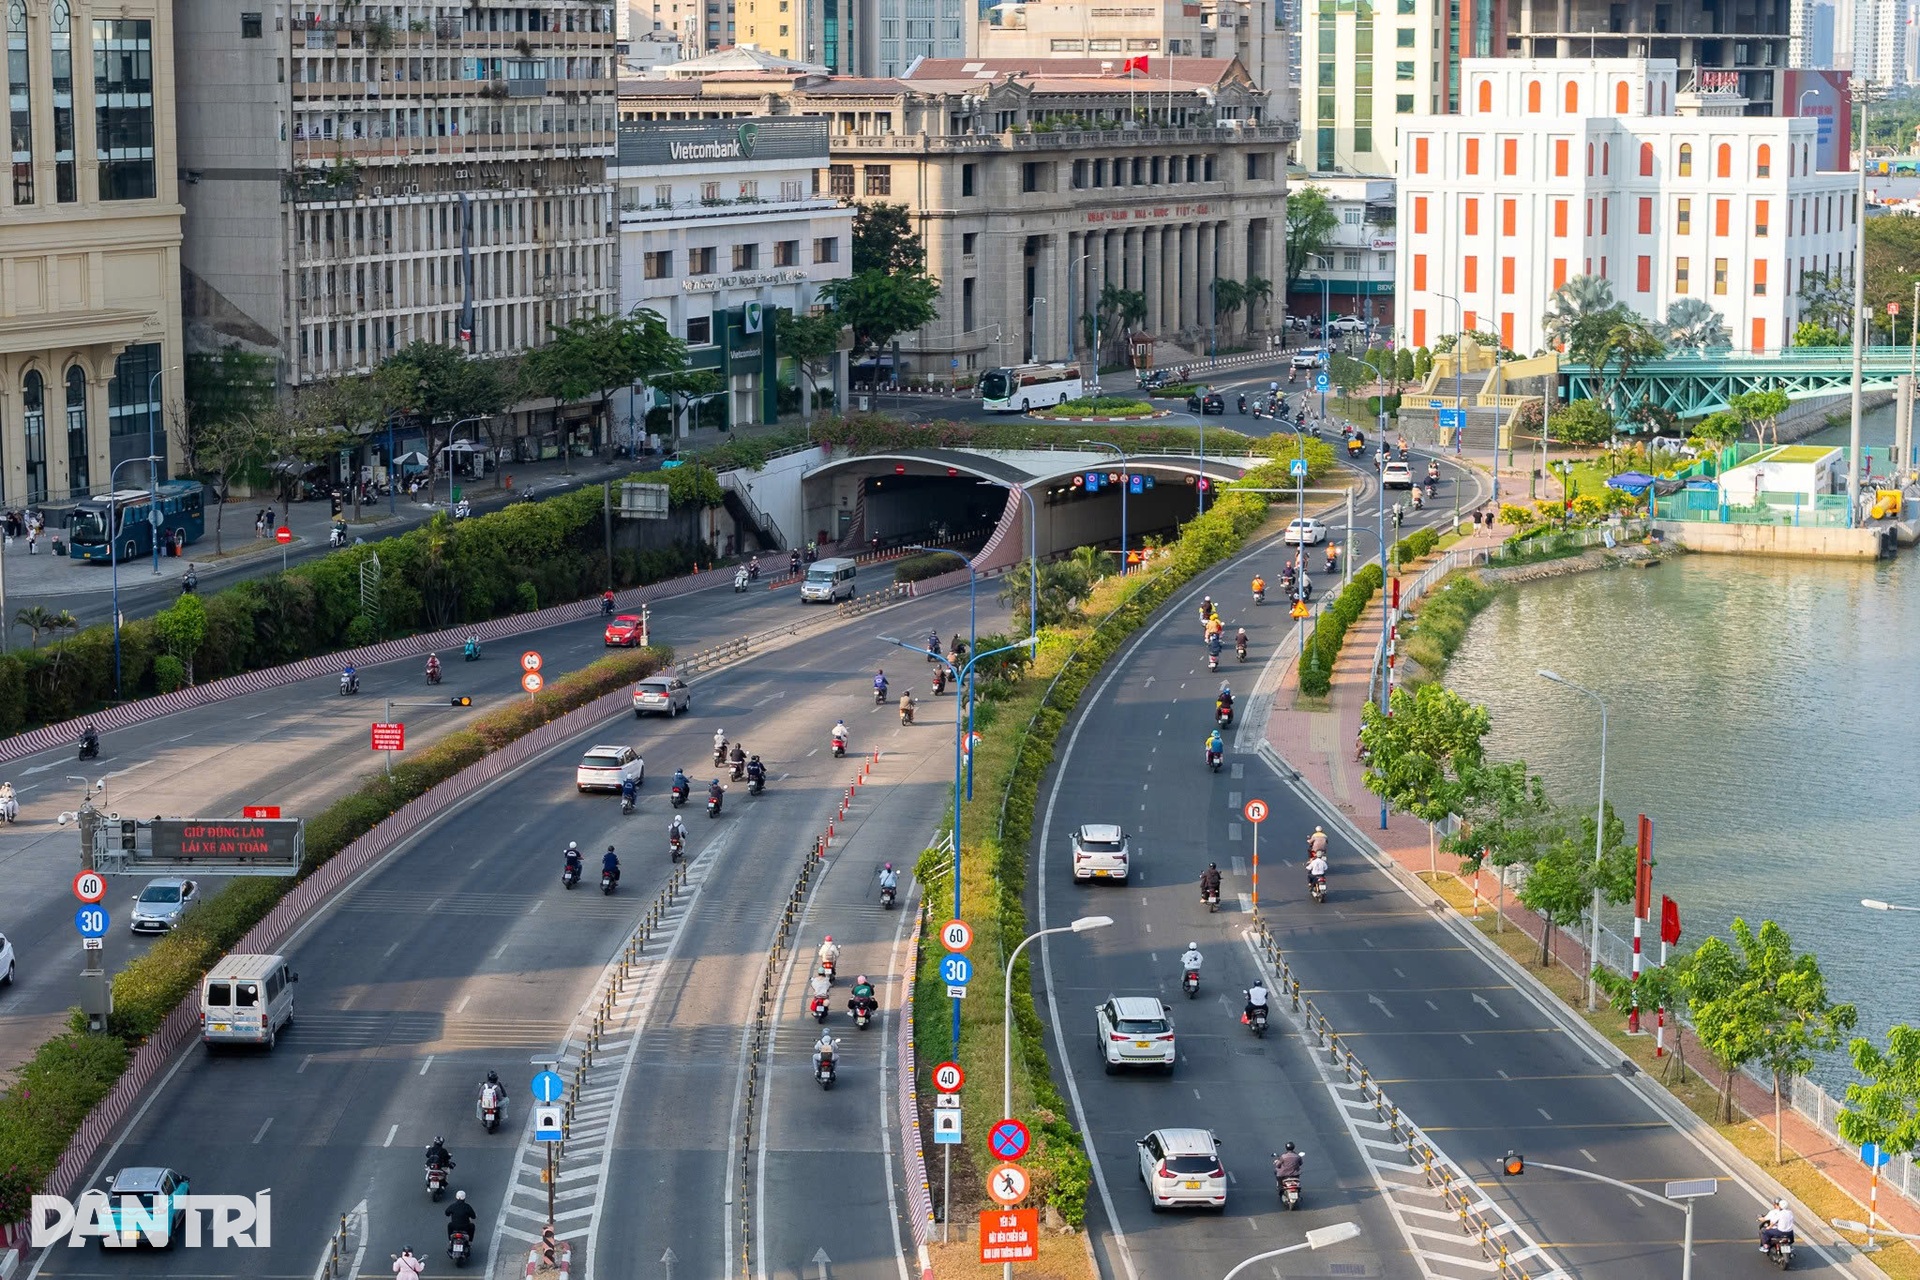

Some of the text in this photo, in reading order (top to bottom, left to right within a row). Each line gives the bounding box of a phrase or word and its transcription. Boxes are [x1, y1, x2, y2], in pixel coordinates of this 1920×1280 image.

[670, 139, 740, 160] Vietcombank
[730, 347, 762, 359] Vietcombank
[183, 825, 206, 838] GIỮ
[207, 825, 240, 838] ĐÚNG
[181, 840, 269, 853] LÁI XE AN TOÀN
[83, 879, 97, 893] 60
[81, 910, 103, 932] 30
[949, 928, 963, 943] 60
[946, 959, 967, 981] 30
[941, 1071, 954, 1085] 40
